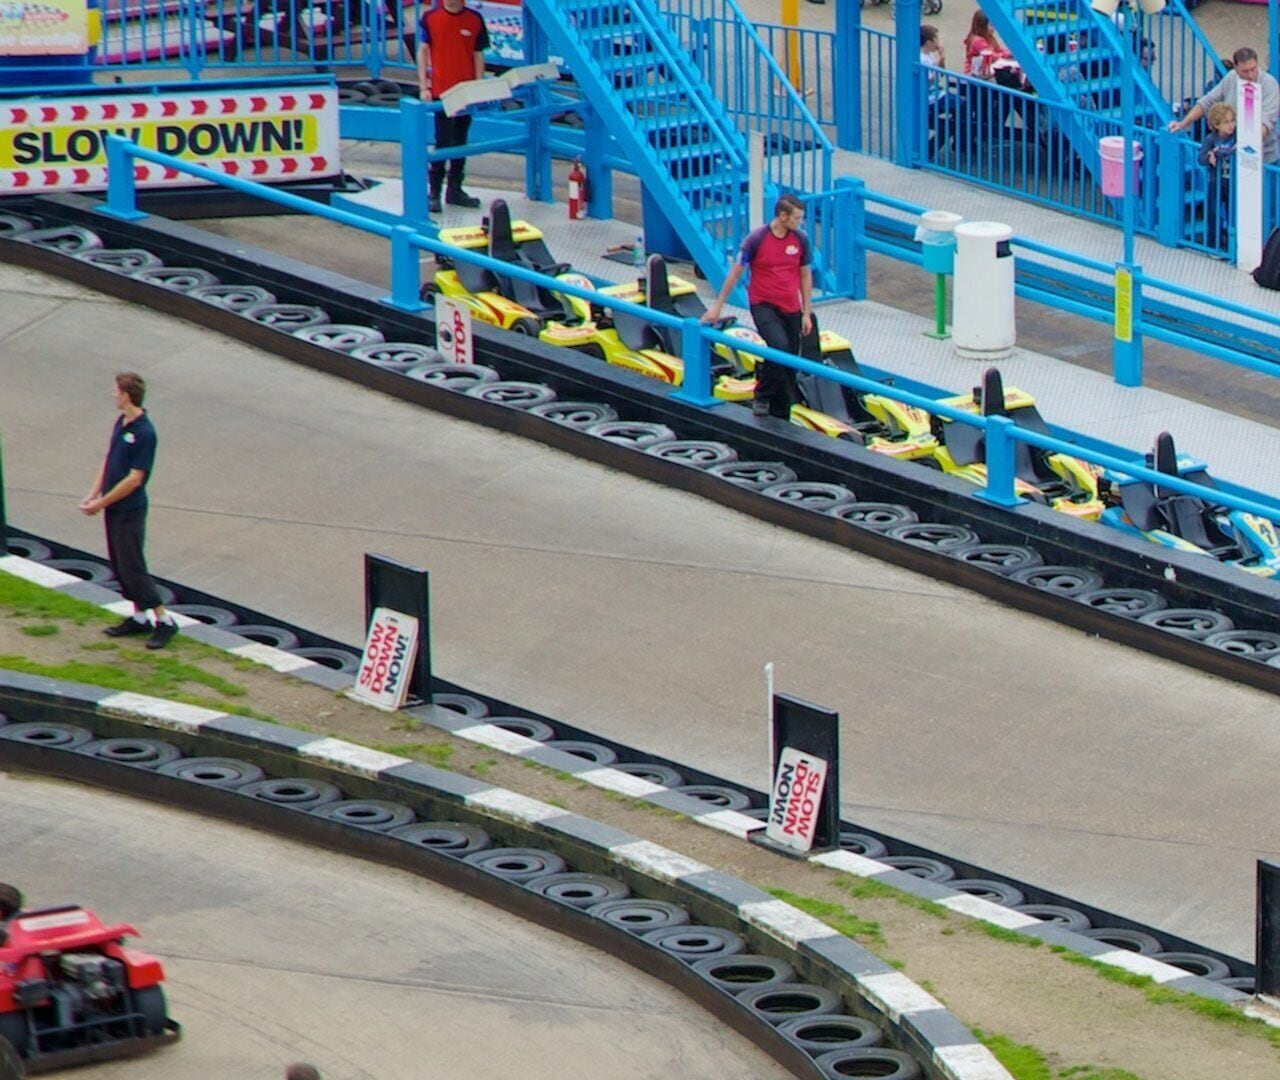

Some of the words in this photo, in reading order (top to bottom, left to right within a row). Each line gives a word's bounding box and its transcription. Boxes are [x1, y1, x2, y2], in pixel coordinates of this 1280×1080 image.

[156, 118, 304, 157] DOWN!
[360, 622, 384, 687] SLOW
[370, 625, 398, 695] DOWN
[384, 634, 409, 694] NOW!
[772, 763, 795, 826] NOW!
[783, 764, 808, 835] DOWN
[797, 772, 820, 838] SLOW
